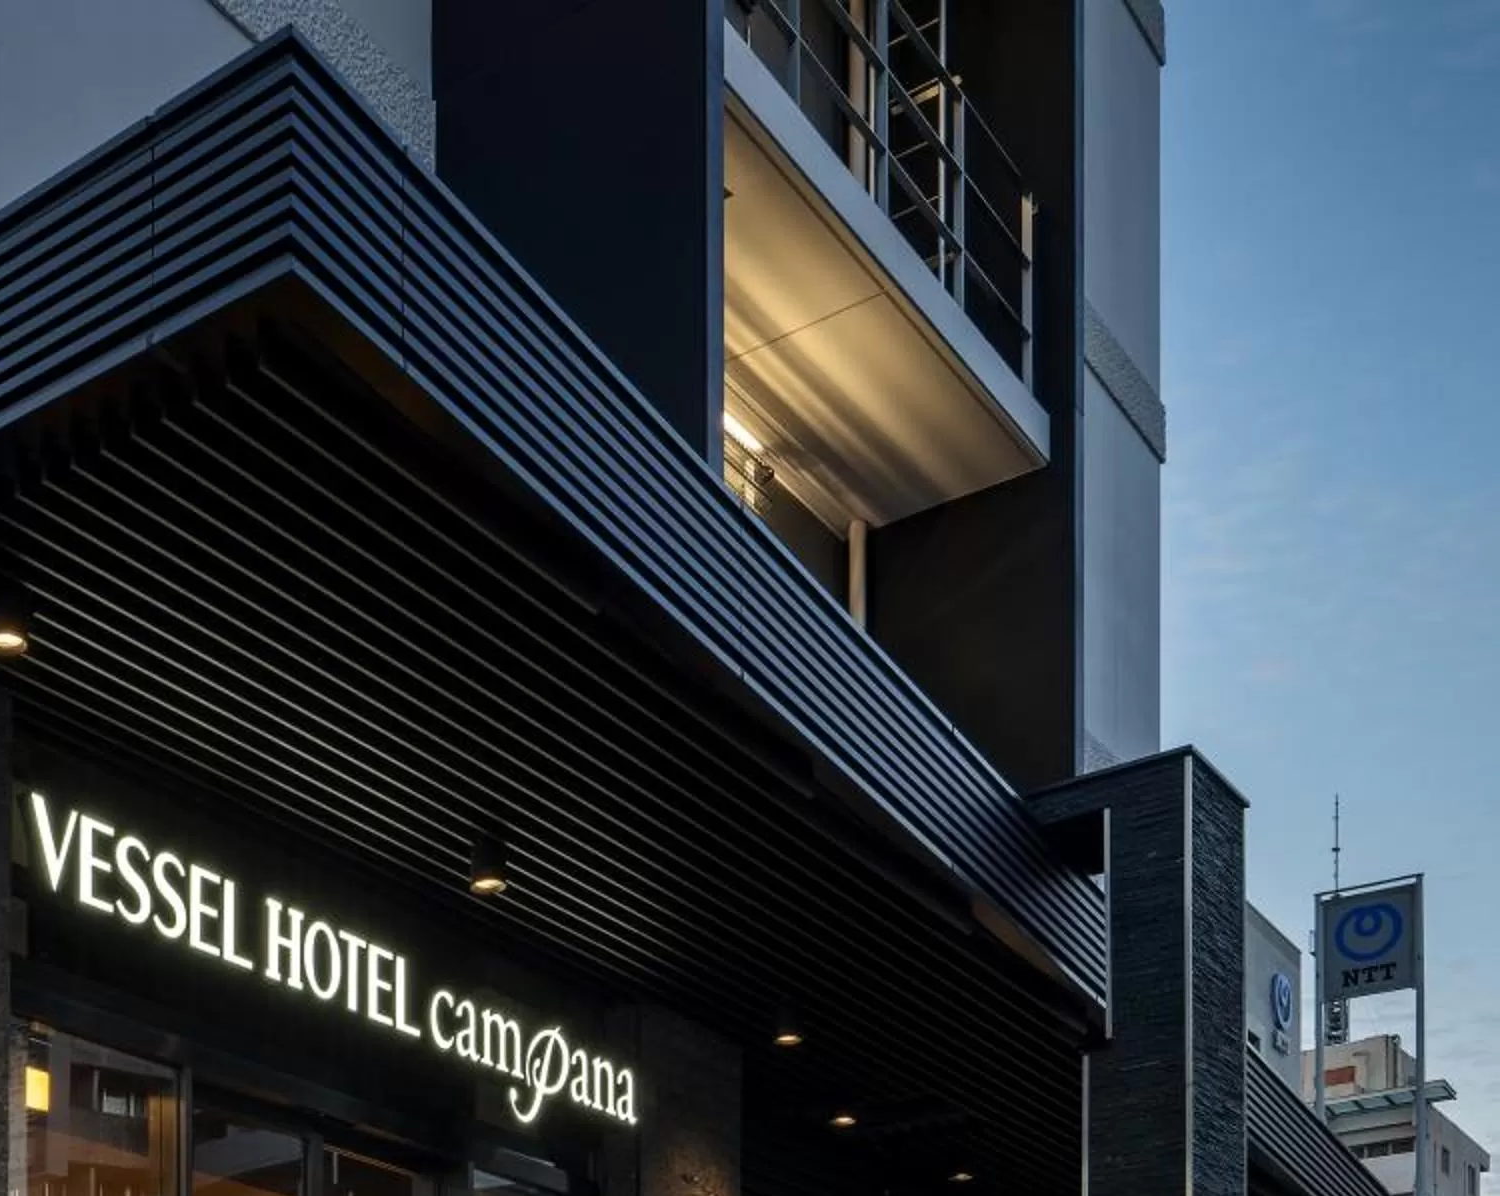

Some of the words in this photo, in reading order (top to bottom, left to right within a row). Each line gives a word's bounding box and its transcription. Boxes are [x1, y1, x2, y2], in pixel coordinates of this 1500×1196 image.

[31, 791, 253, 970] VESSEL
[265, 897, 421, 1038] HOTEL
[429, 989, 638, 1124] campana
[1341, 962, 1397, 987] NTT
